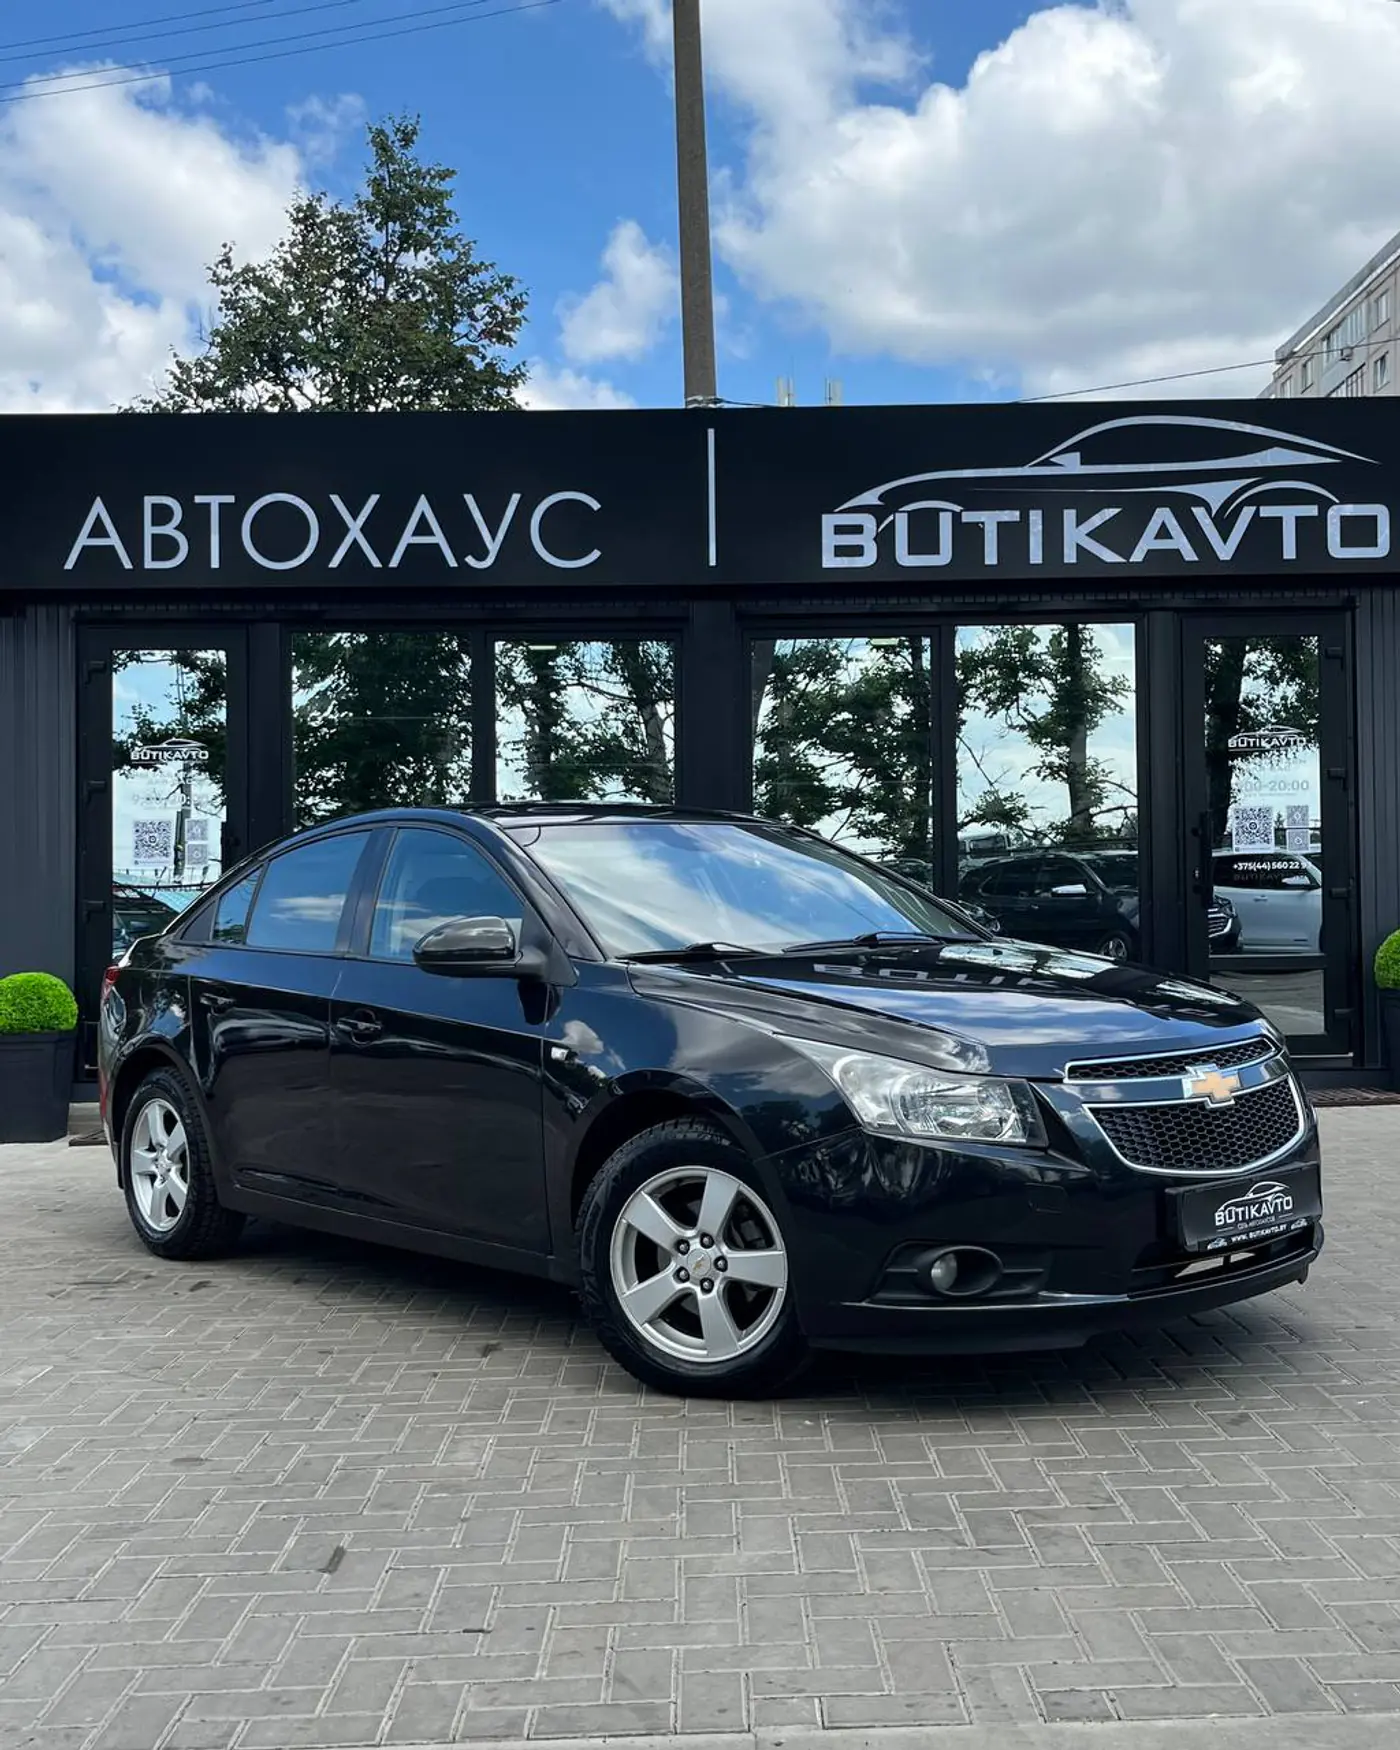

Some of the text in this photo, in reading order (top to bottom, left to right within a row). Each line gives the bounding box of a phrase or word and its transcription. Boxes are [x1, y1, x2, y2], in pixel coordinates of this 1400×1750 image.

[63, 490, 602, 571] АВТОХАУС
[821, 502, 1391, 569] BUTIKAVTO
[131, 750, 209, 760] BUTIKAVTO
[1228, 737, 1307, 748] BUTIKAVTO
[1214, 1196, 1294, 1226] BUTIKAVTO
